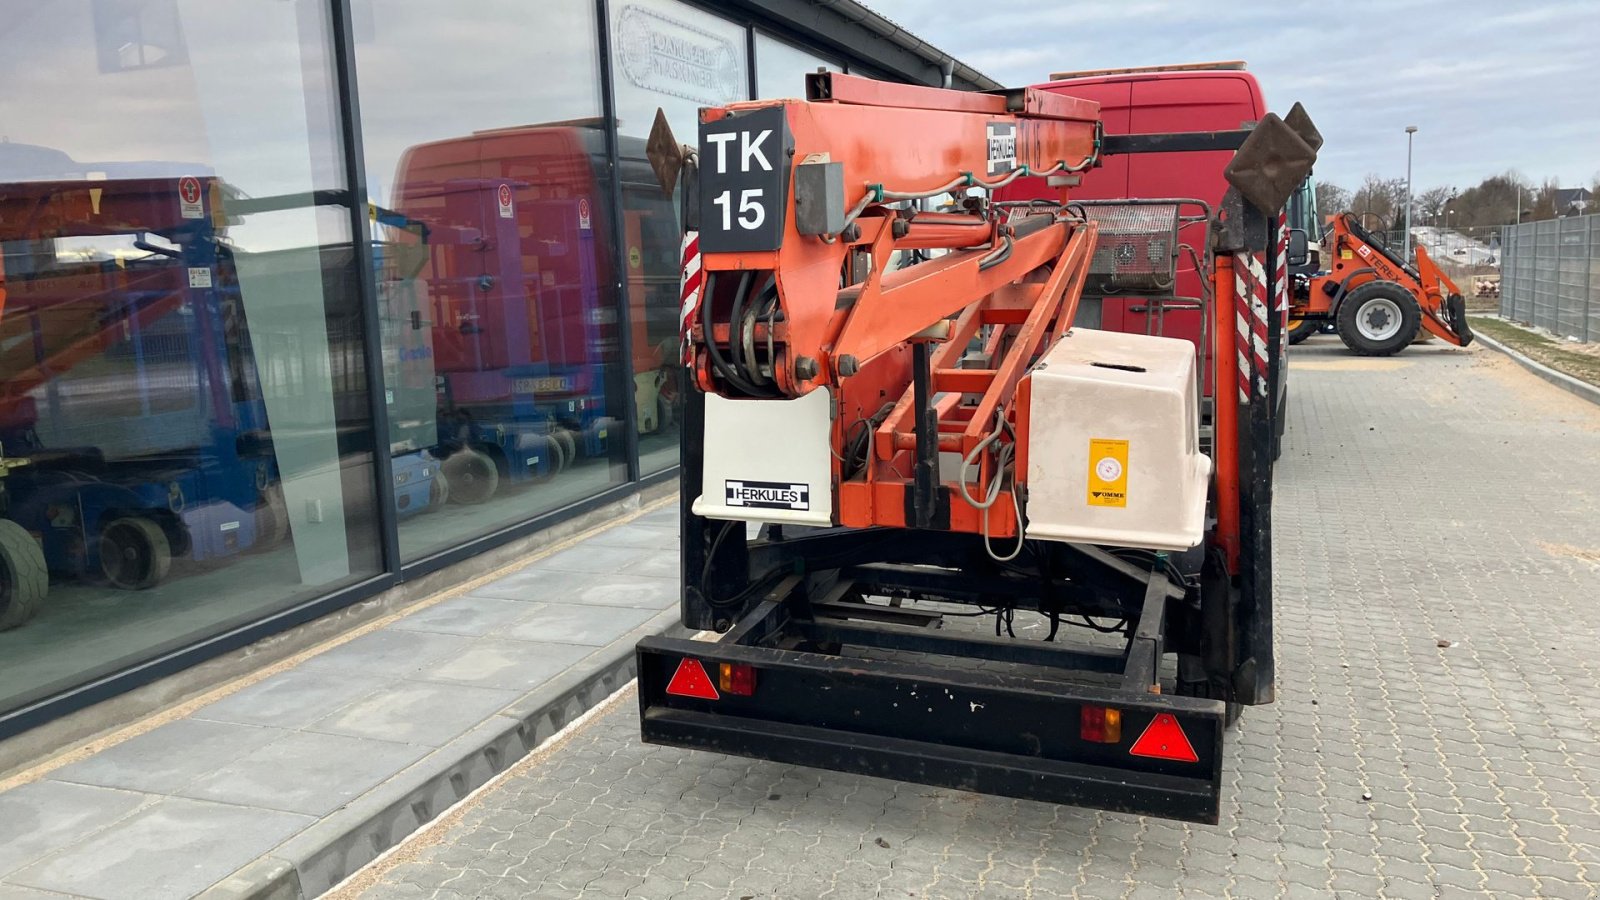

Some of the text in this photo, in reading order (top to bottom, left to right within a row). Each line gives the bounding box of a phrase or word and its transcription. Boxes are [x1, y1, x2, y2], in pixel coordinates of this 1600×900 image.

[706, 129, 774, 174] TK
[989, 138, 1014, 160] HERKULES
[713, 188, 766, 231] 15
[1370, 254, 1402, 282] TEREX
[736, 488, 798, 503] HERKULES
